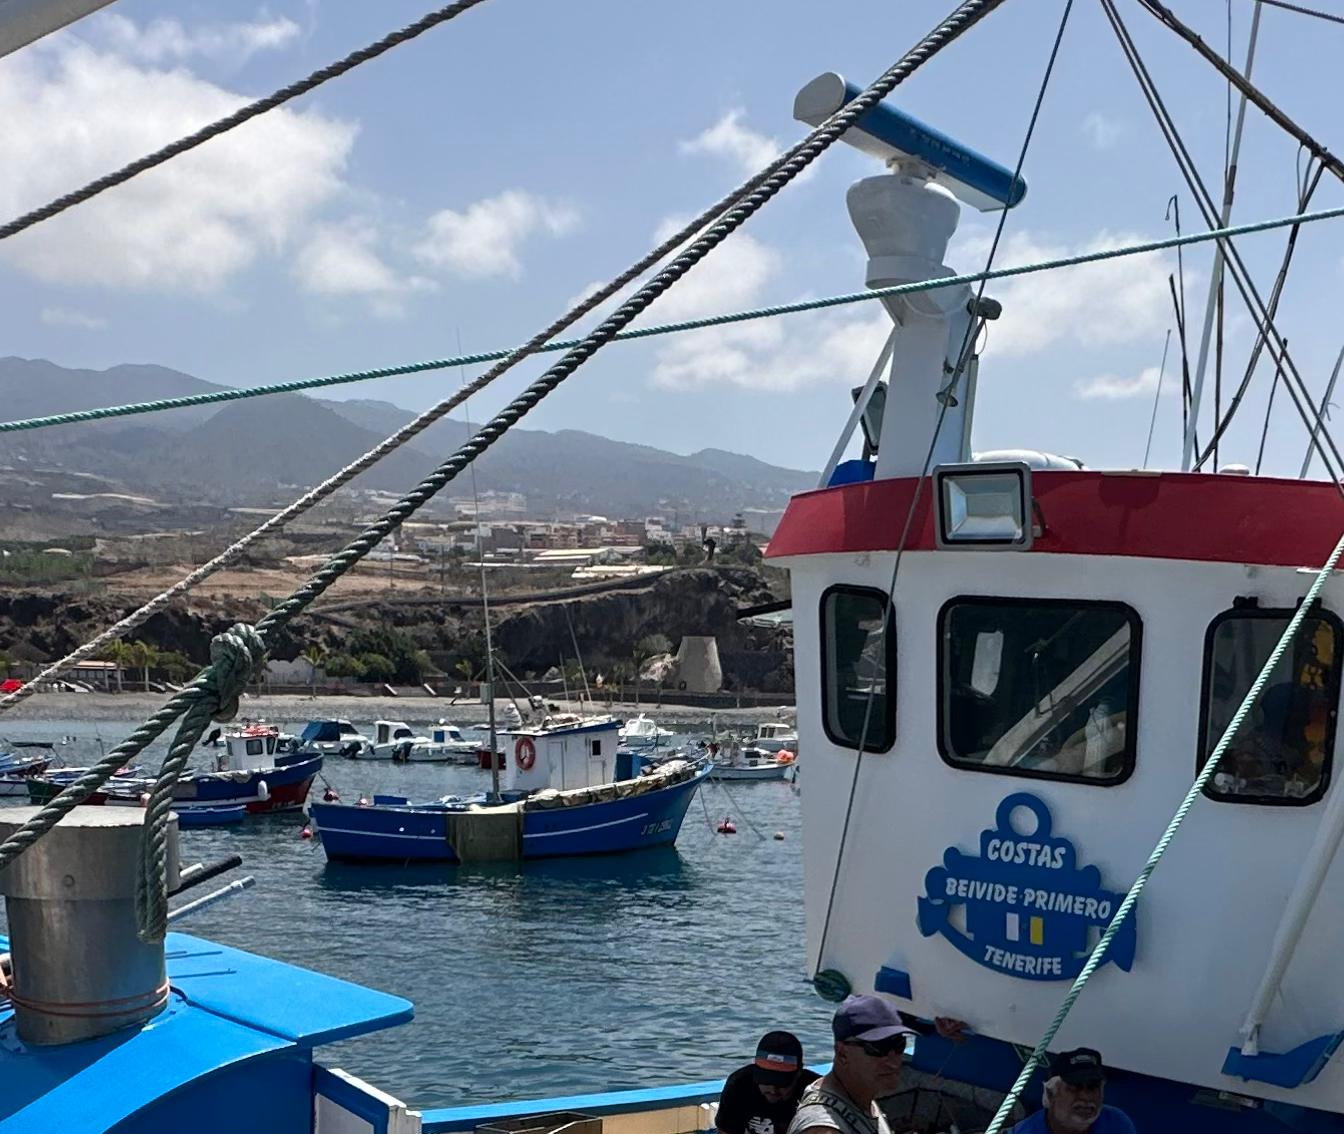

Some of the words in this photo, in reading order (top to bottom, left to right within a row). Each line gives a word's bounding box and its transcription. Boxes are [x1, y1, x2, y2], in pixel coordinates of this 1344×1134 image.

[987, 839, 1066, 869] COSTAS
[945, 877, 1019, 904] BEIVIDE
[1023, 888, 1111, 919] PRIMERO
[984, 945, 1062, 975] TENERIFE
